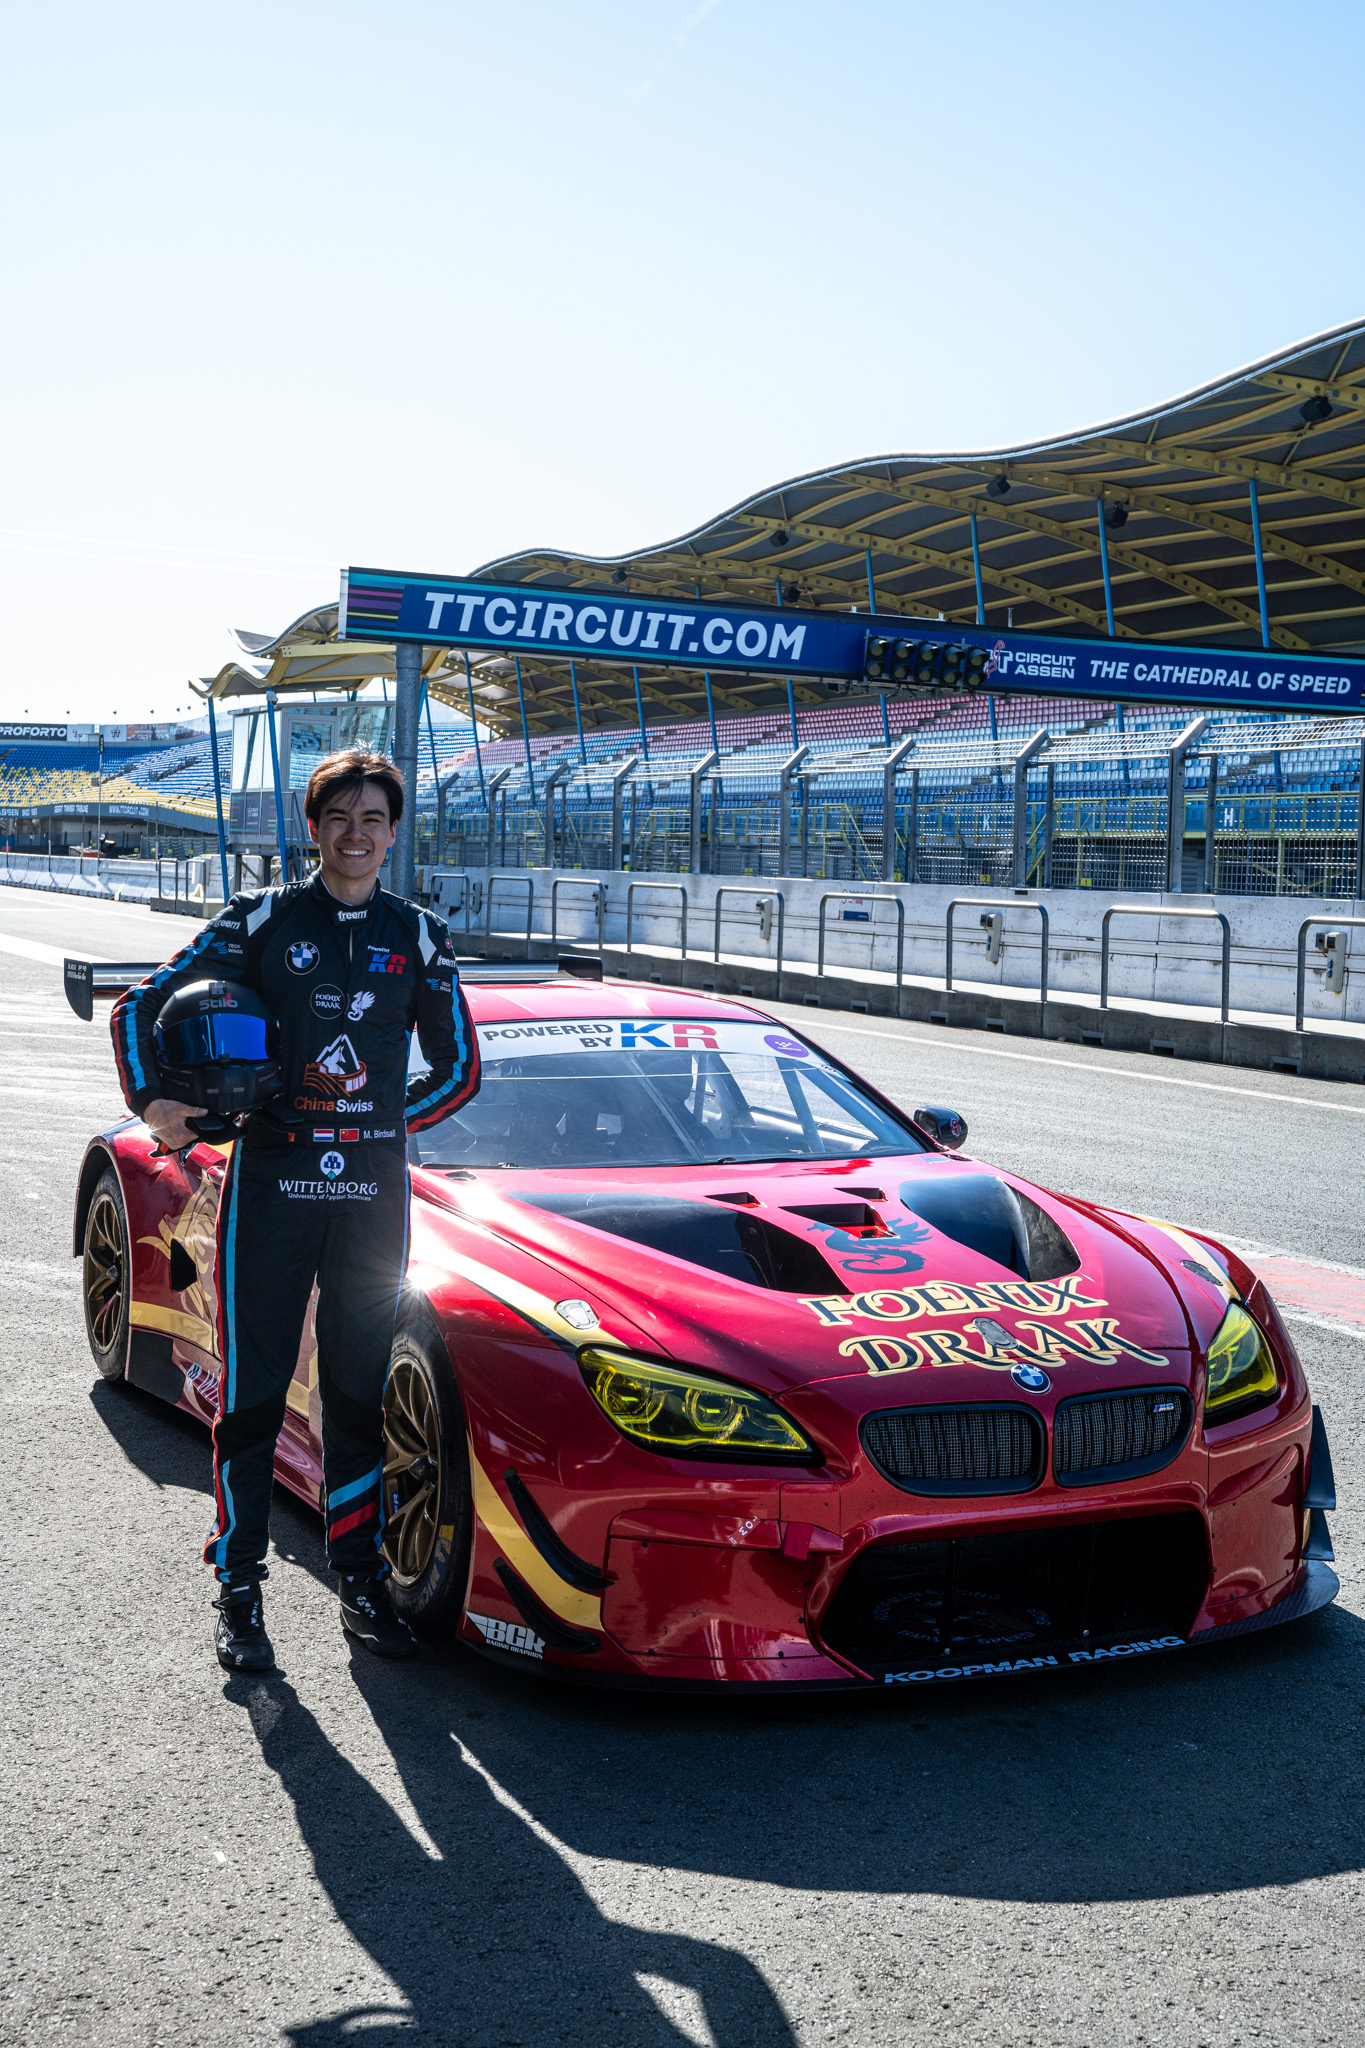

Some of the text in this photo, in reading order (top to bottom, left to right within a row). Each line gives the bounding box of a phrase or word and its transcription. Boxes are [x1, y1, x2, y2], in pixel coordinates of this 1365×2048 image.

[424, 591, 806, 661] TTCIRCUIT.COM
[1015, 652, 1076, 666] CIRCUIT
[1014, 664, 1075, 679] ASSEN
[1089, 660, 1351, 694] THE CATHEDRAL OF SPEED
[337, 910, 368, 921] freem
[289, 943, 318, 955] BMW
[368, 954, 406, 975] KR
[199, 996, 238, 1010] Stilo
[315, 1001, 341, 1009] DRAAK
[482, 1023, 614, 1041] POWERED
[620, 1023, 720, 1049] KR
[580, 1036, 613, 1048] BY
[294, 1096, 374, 1113] ChinaSwiss
[363, 1129, 396, 1139] M. Birdsall
[279, 1179, 378, 1195] WITTENBORG
[287, 1192, 317, 1200] University
[347, 1194, 372, 1202] Sciences
[797, 1276, 1109, 1326] FOENIX
[485, 1617, 546, 1653] BGK
[485, 1639, 544, 1660] RACING GRAPHICS
[884, 1636, 1186, 1683] KOOPMAN RACING
